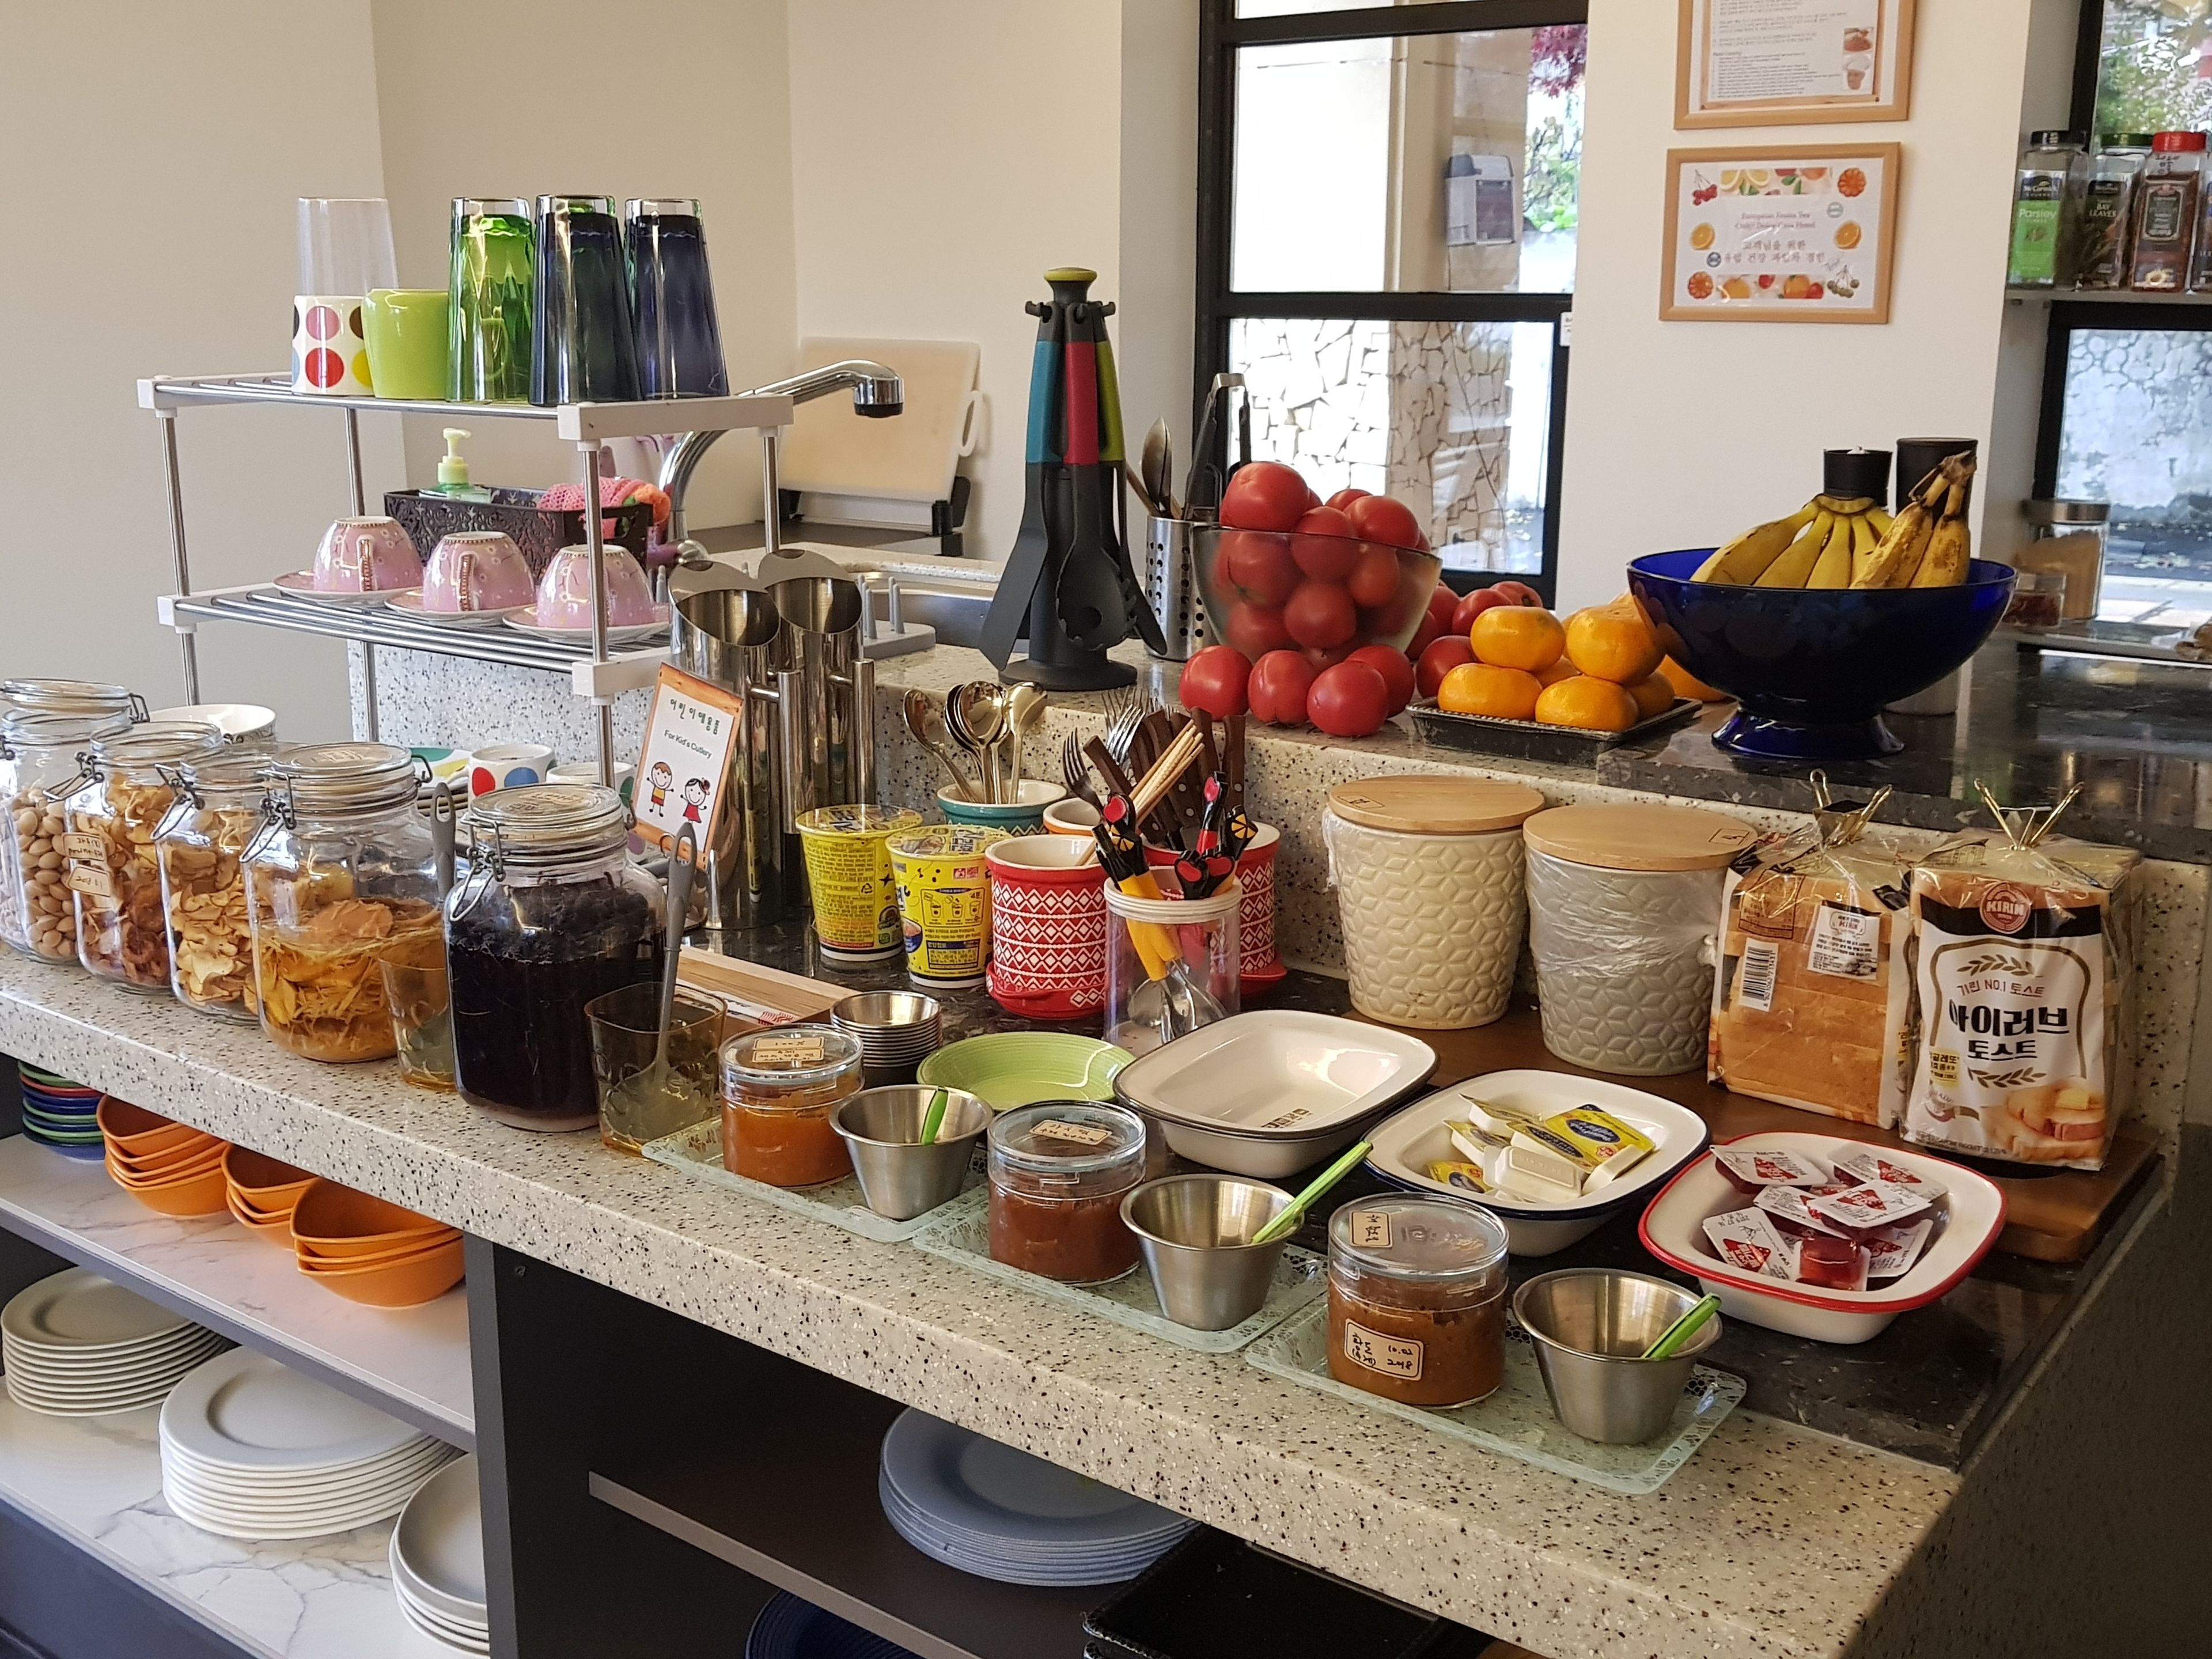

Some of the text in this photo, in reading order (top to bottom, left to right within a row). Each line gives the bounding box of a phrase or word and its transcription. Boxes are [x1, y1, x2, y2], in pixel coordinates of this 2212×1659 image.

[2019, 209, 2057, 219] Parsley
[664, 729, 675, 741] For
[1986, 900, 2024, 916] KIRIN
[1957, 979, 2044, 998] 기린 NO.1 토스트
[1949, 999, 2069, 1037] 아이러브
[1967, 1039, 2038, 1061] 토스트
